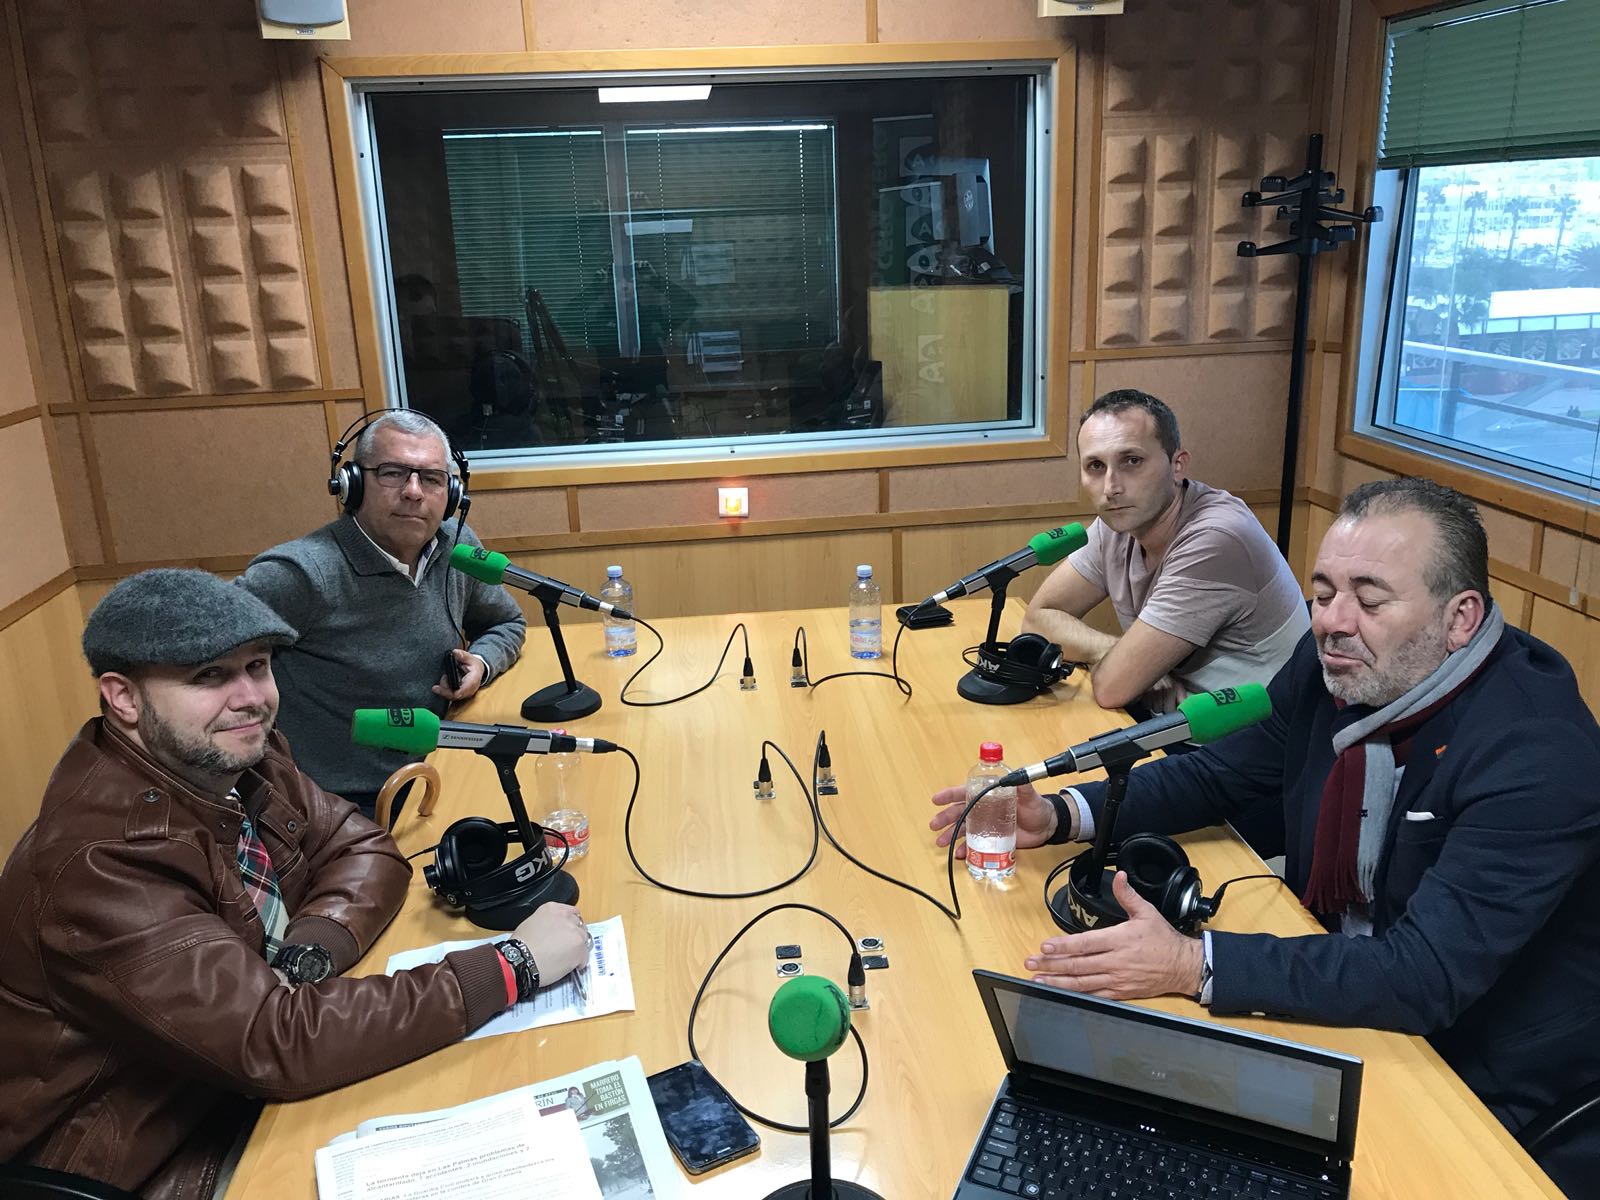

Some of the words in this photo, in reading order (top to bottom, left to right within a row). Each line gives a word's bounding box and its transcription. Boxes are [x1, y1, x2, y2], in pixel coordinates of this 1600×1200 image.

[977, 656, 1000, 671] AK
[515, 848, 550, 882] KG
[1067, 889, 1099, 928] AK
[590, 1074, 620, 1089] MARRERO
[595, 1084, 614, 1095] TOMA
[613, 1081, 622, 1090] EL
[594, 1102, 604, 1112] EN
[604, 1094, 626, 1108] FIRGAS
